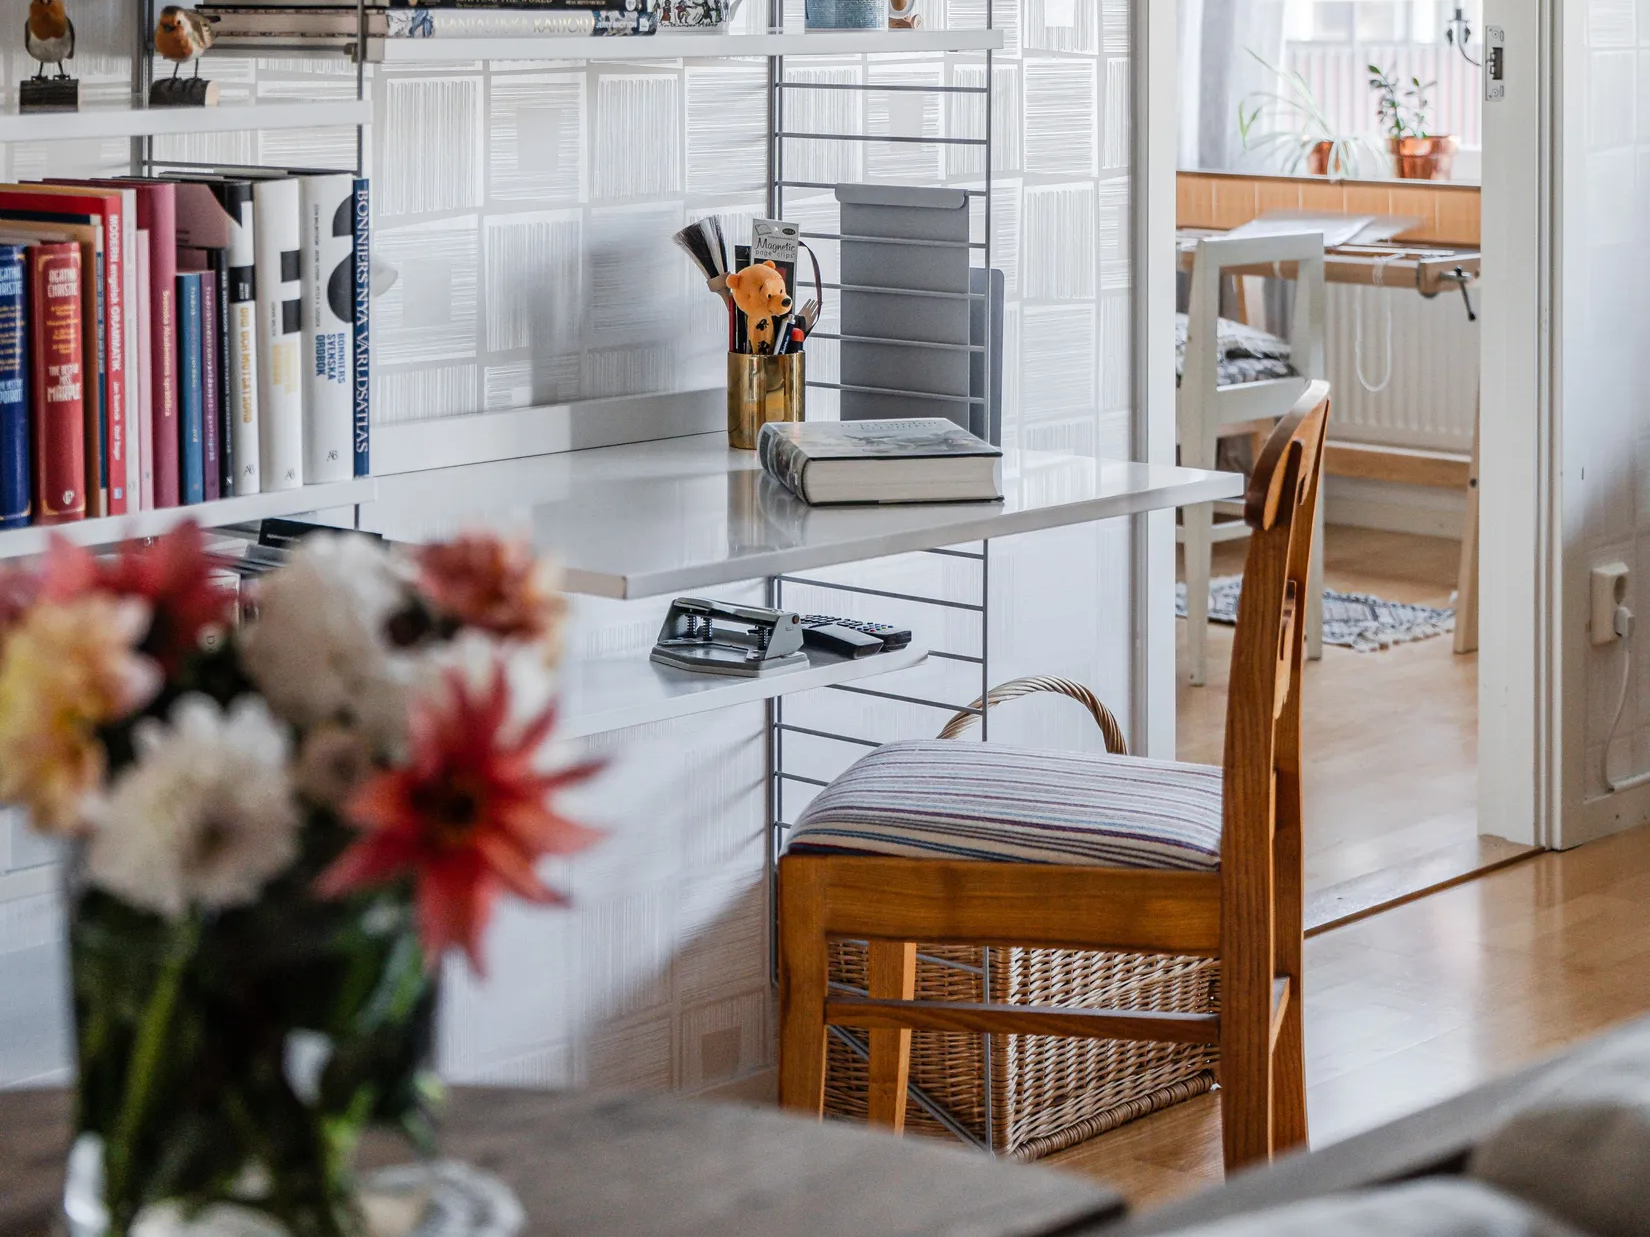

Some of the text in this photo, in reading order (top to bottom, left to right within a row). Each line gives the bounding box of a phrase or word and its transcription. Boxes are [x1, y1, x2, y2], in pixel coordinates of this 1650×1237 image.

[756, 238, 796, 253] Magnetic
[47, 282, 78, 298] CHRISTIE
[49, 268, 77, 283] AGATHA
[108, 214, 121, 371] MODERN engelsk GRAMMATIK
[162, 290, 170, 324] Svenska
[356, 190, 369, 453] BONNIERS NYA VÄRLDSATLAS
[163, 327, 172, 376] Akademiens
[316, 335, 326, 376] ORDBOK
[327, 334, 336, 380] SVENSKA
[337, 333, 345, 384] BONNIERS
